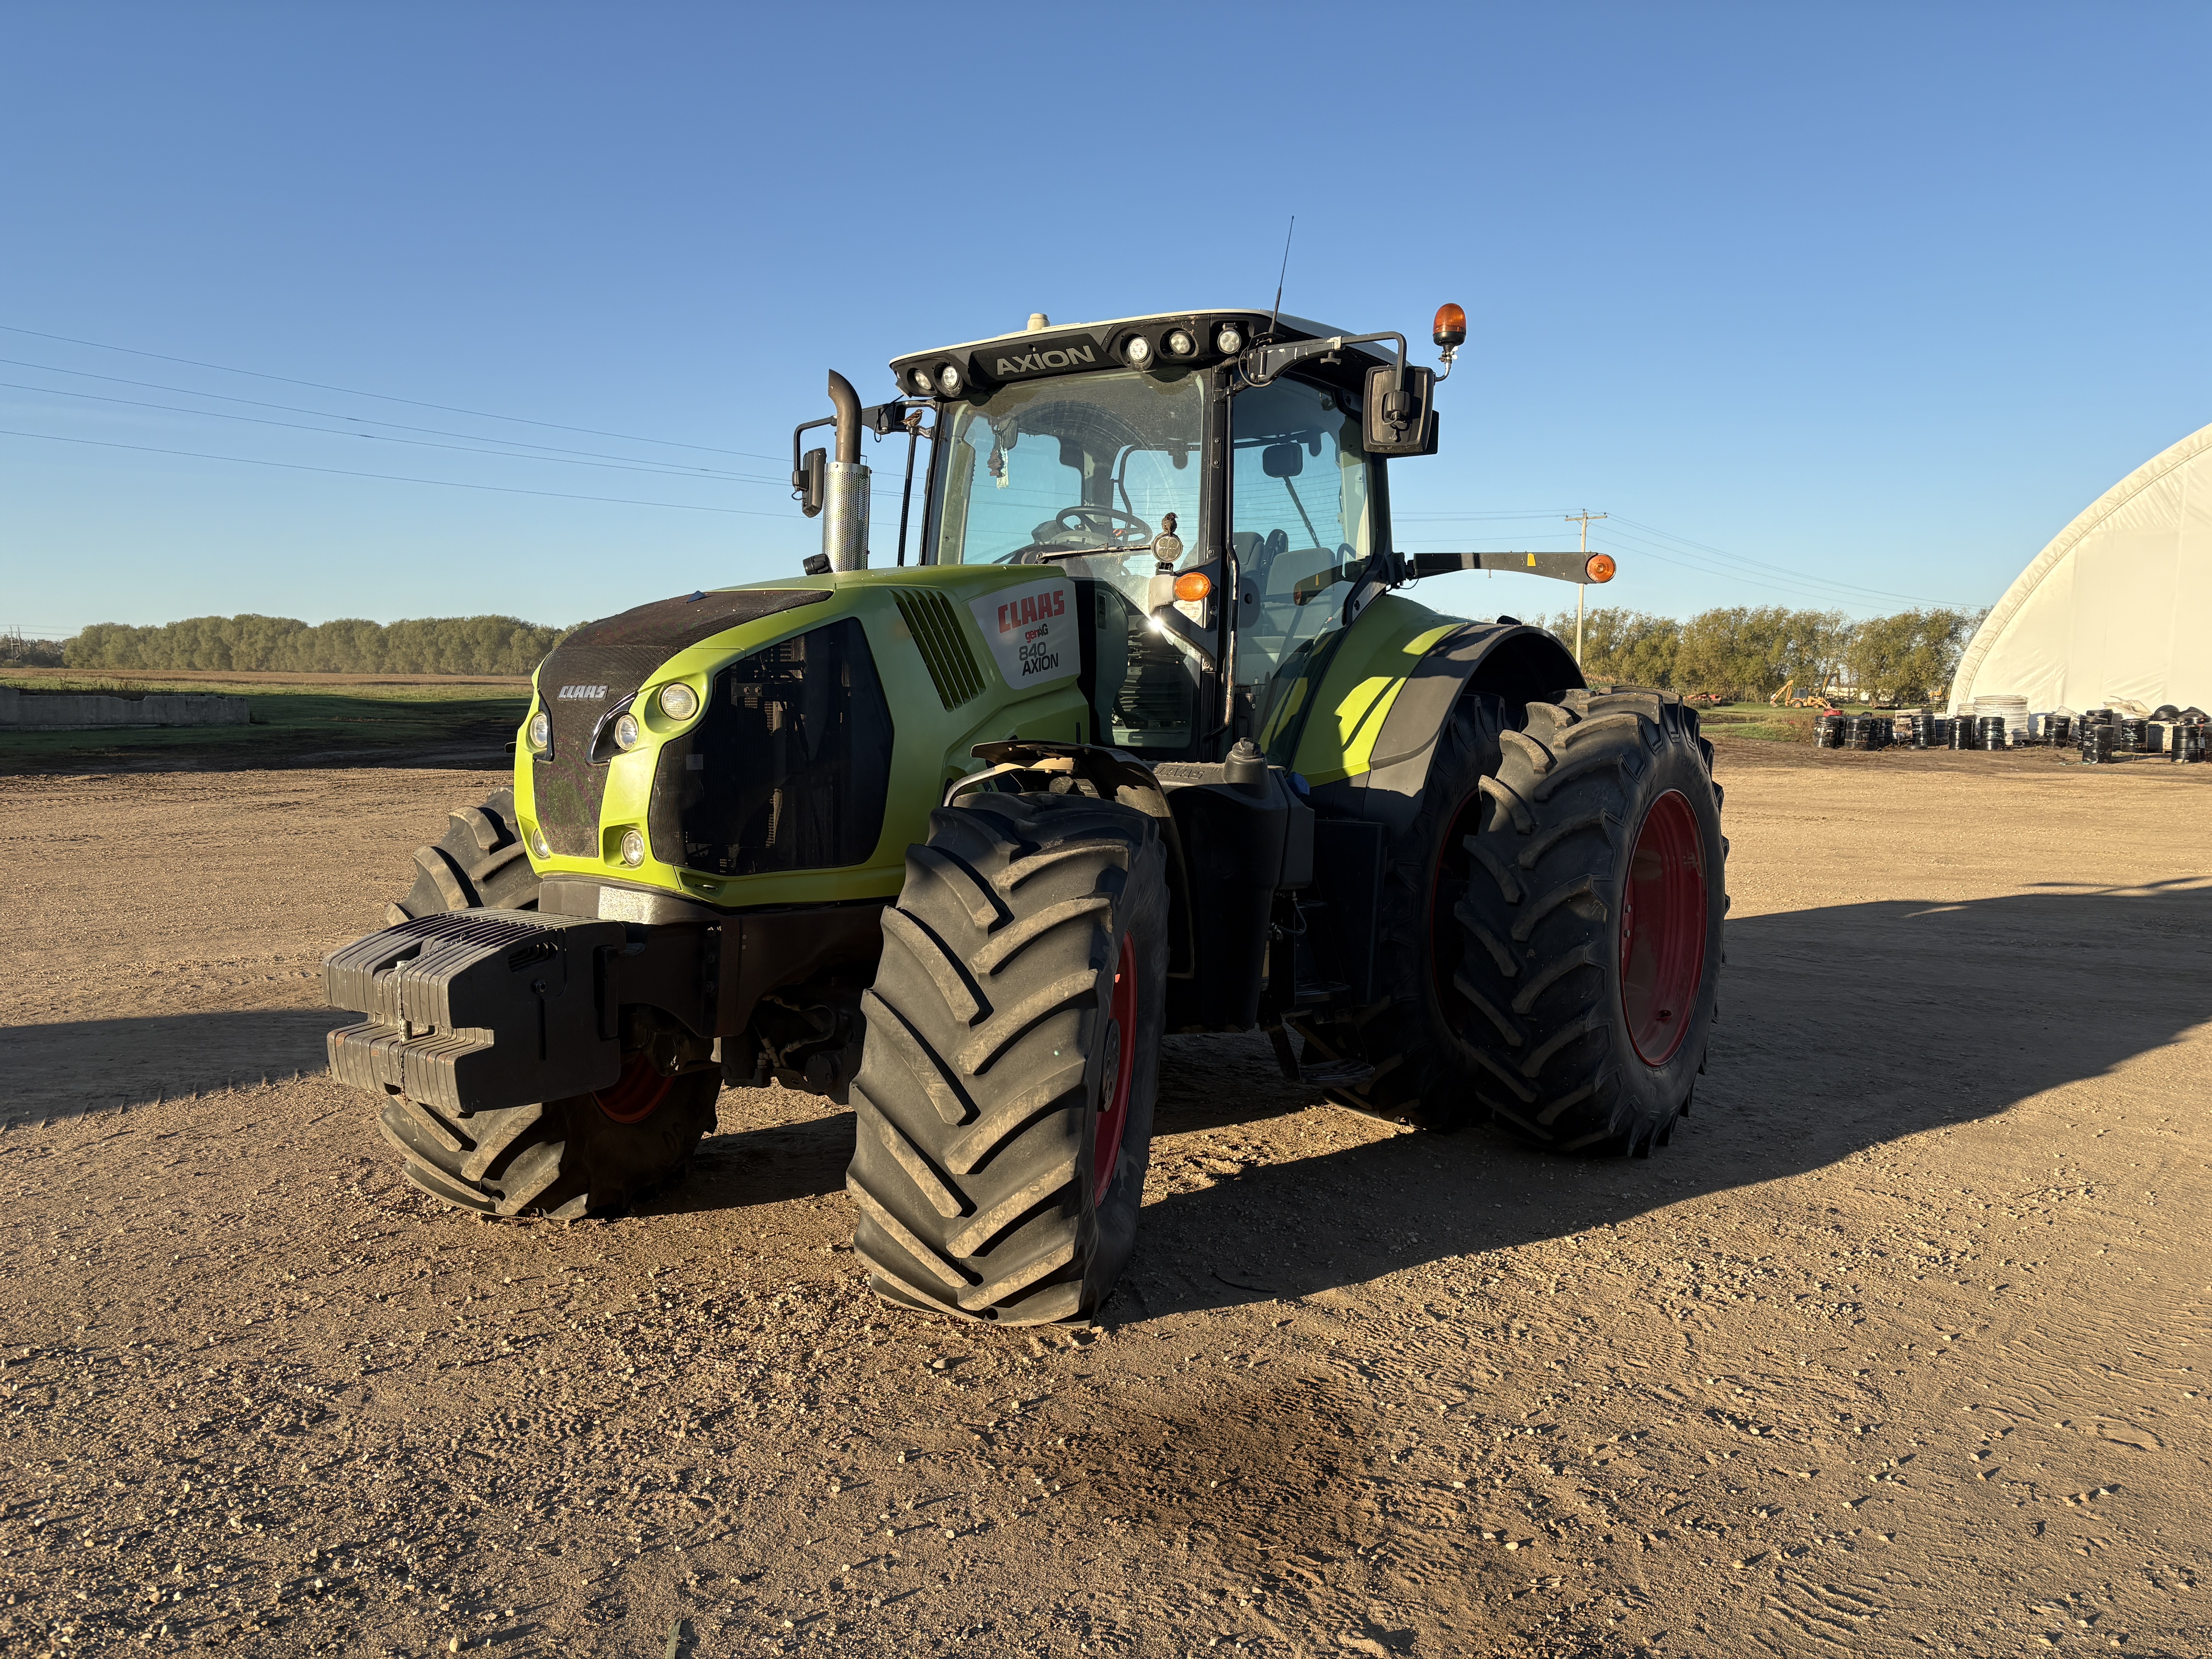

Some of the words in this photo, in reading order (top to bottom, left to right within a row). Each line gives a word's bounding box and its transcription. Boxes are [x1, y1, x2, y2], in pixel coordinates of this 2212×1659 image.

[997, 345, 1096, 375] AXION
[998, 590, 1065, 633] CLAAS
[1019, 642, 1046, 661] 840
[1022, 653, 1058, 676] AXION
[558, 685, 608, 699] CLAAS
